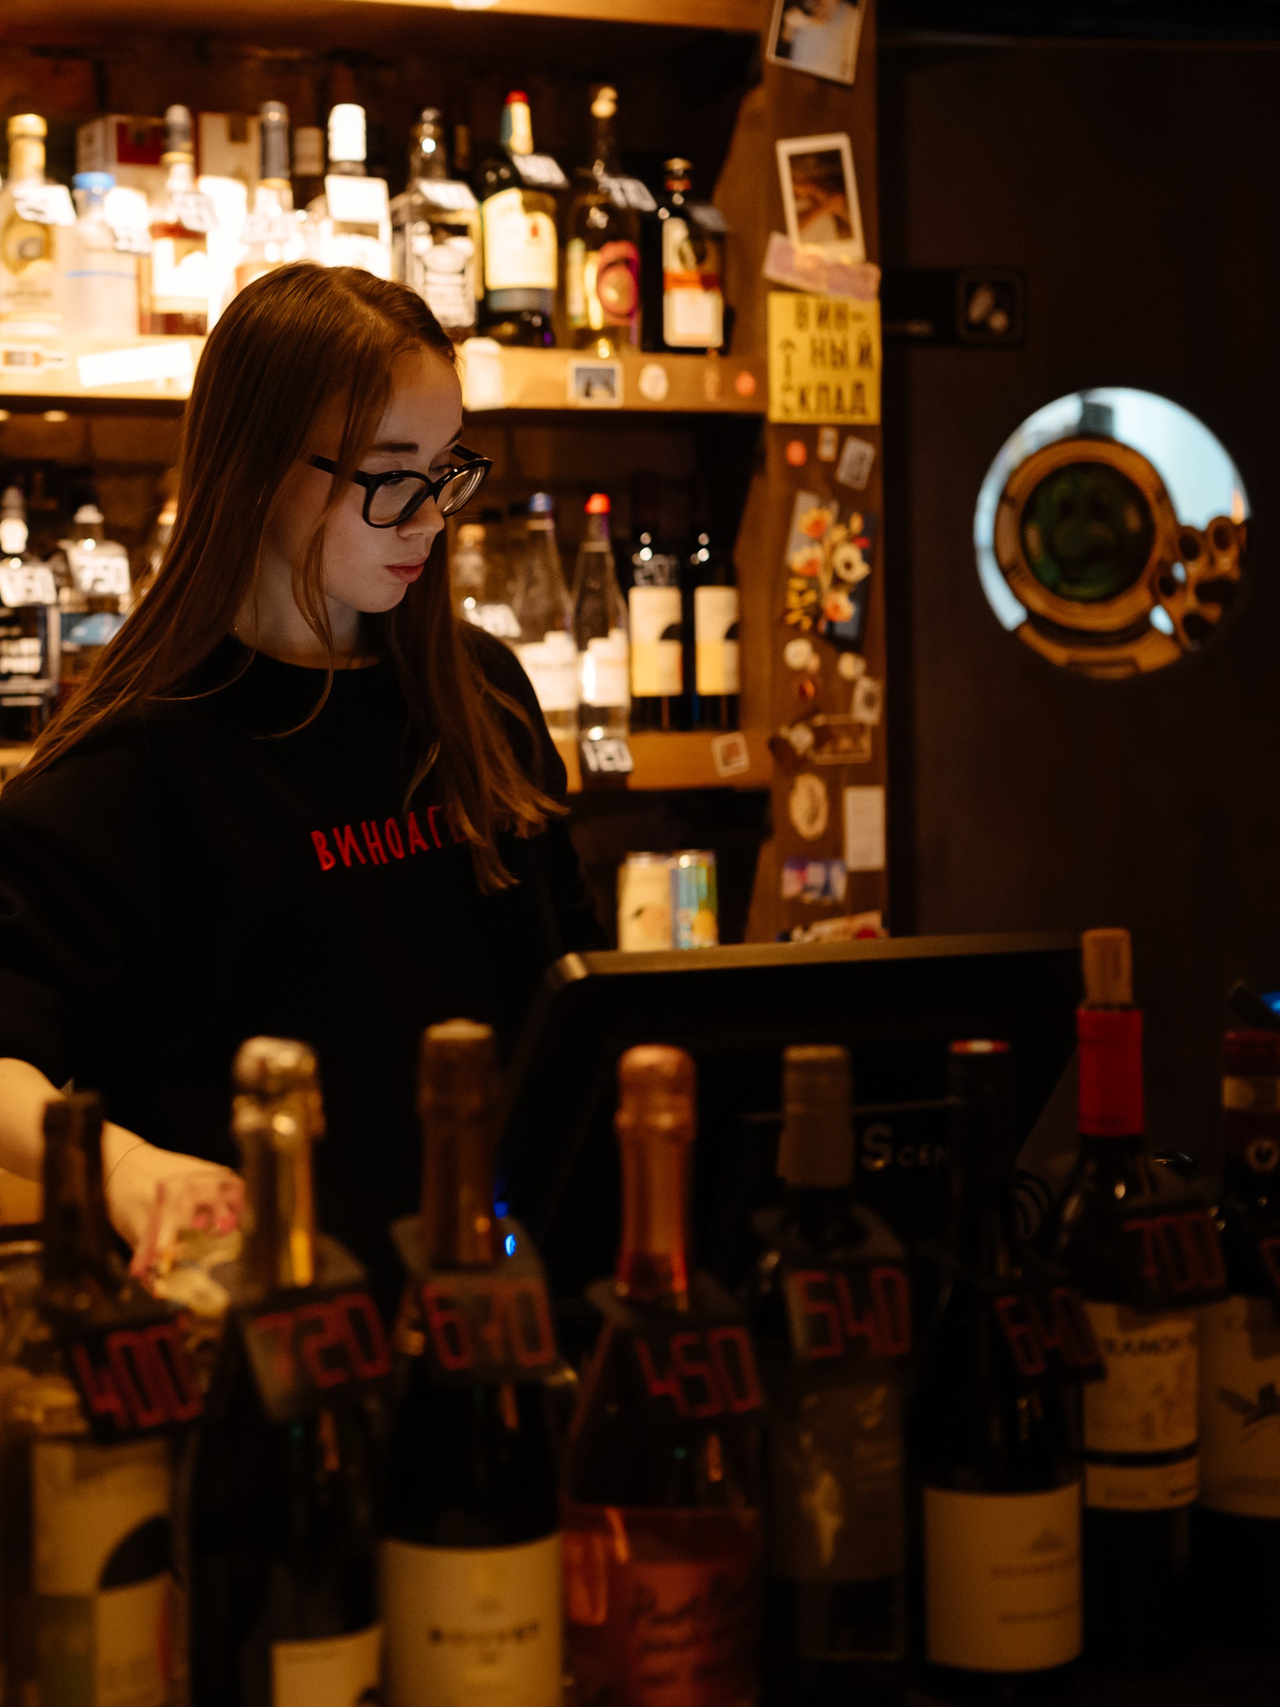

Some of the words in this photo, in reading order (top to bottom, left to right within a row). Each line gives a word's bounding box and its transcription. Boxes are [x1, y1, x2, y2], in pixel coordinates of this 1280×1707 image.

[310, 804, 468, 872] ВИНОАГ
[72, 1318, 205, 1430] 400
[635, 1326, 764, 1419] 450
